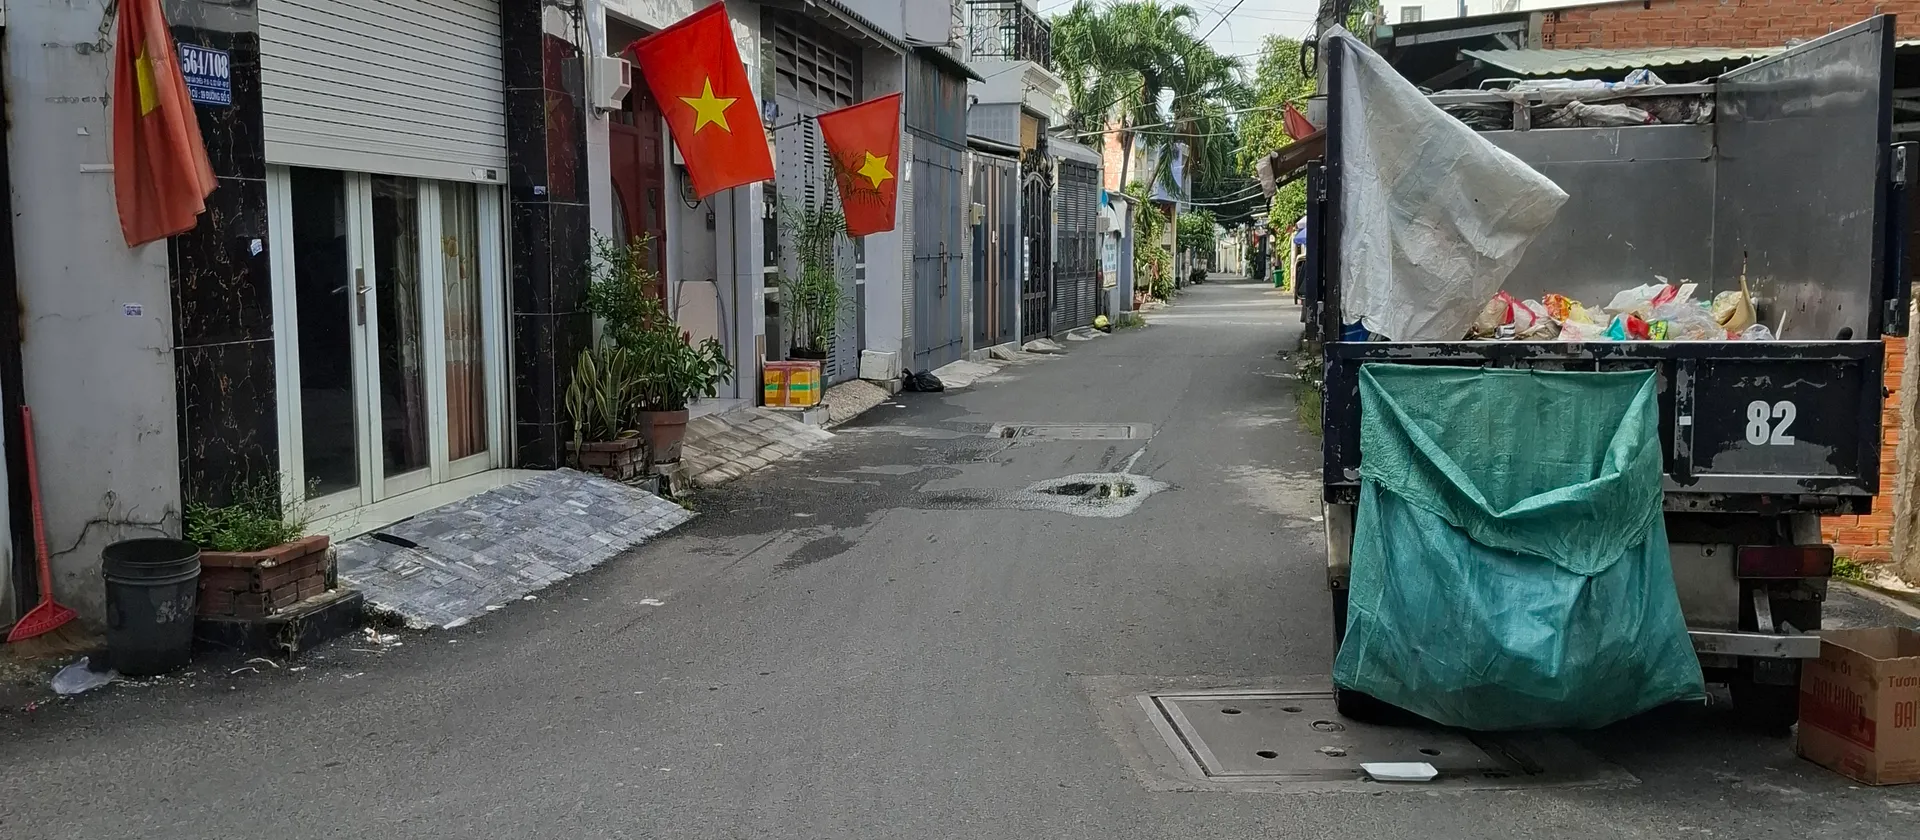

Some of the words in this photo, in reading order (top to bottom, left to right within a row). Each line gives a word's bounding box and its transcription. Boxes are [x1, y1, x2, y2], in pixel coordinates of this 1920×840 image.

[183, 49, 228, 79] 564/108
[1745, 400, 1797, 446] 82
[1887, 675, 1920, 688] Tươn
[1894, 700, 1917, 731] ĐẠI
